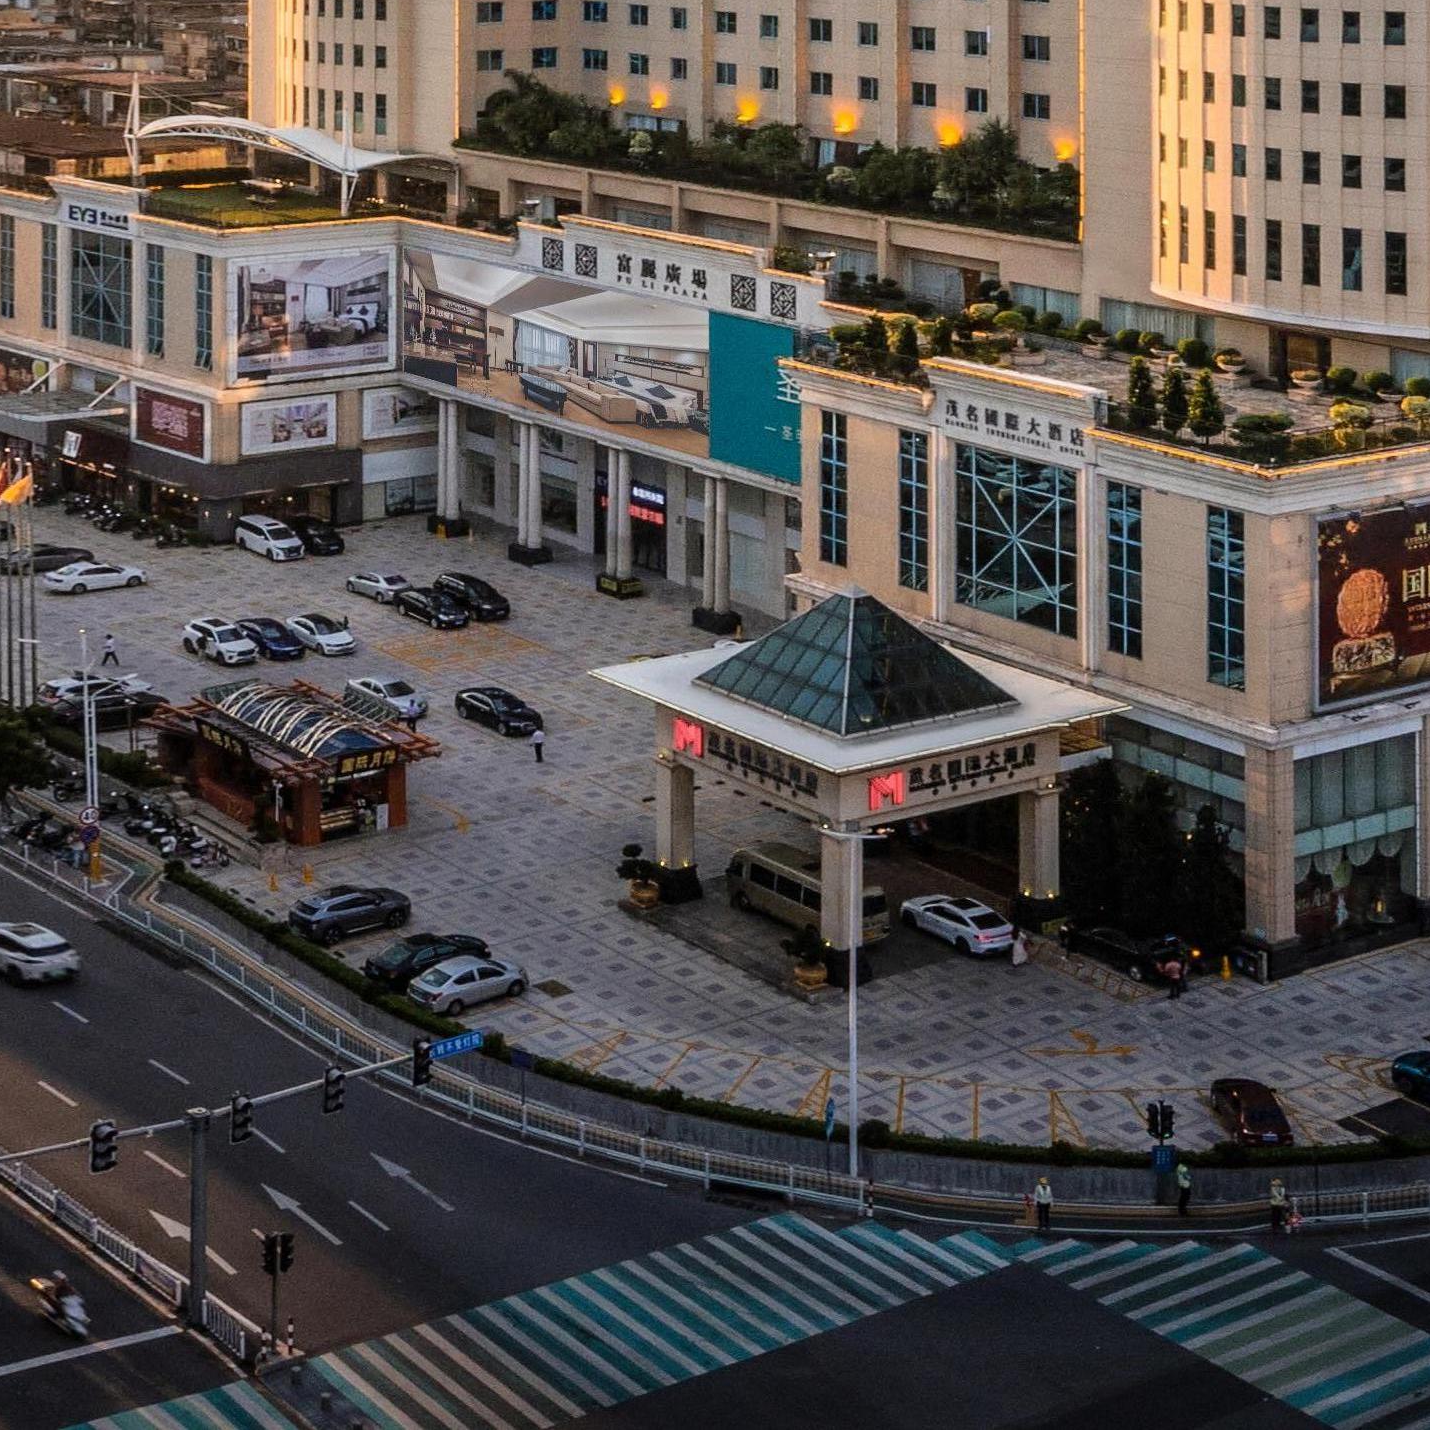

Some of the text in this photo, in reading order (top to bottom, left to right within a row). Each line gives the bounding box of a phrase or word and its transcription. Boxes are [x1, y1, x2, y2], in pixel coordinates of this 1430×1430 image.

[663, 284, 708, 301] PLAZA
[674, 718, 703, 758] M
[869, 768, 905, 811] M
